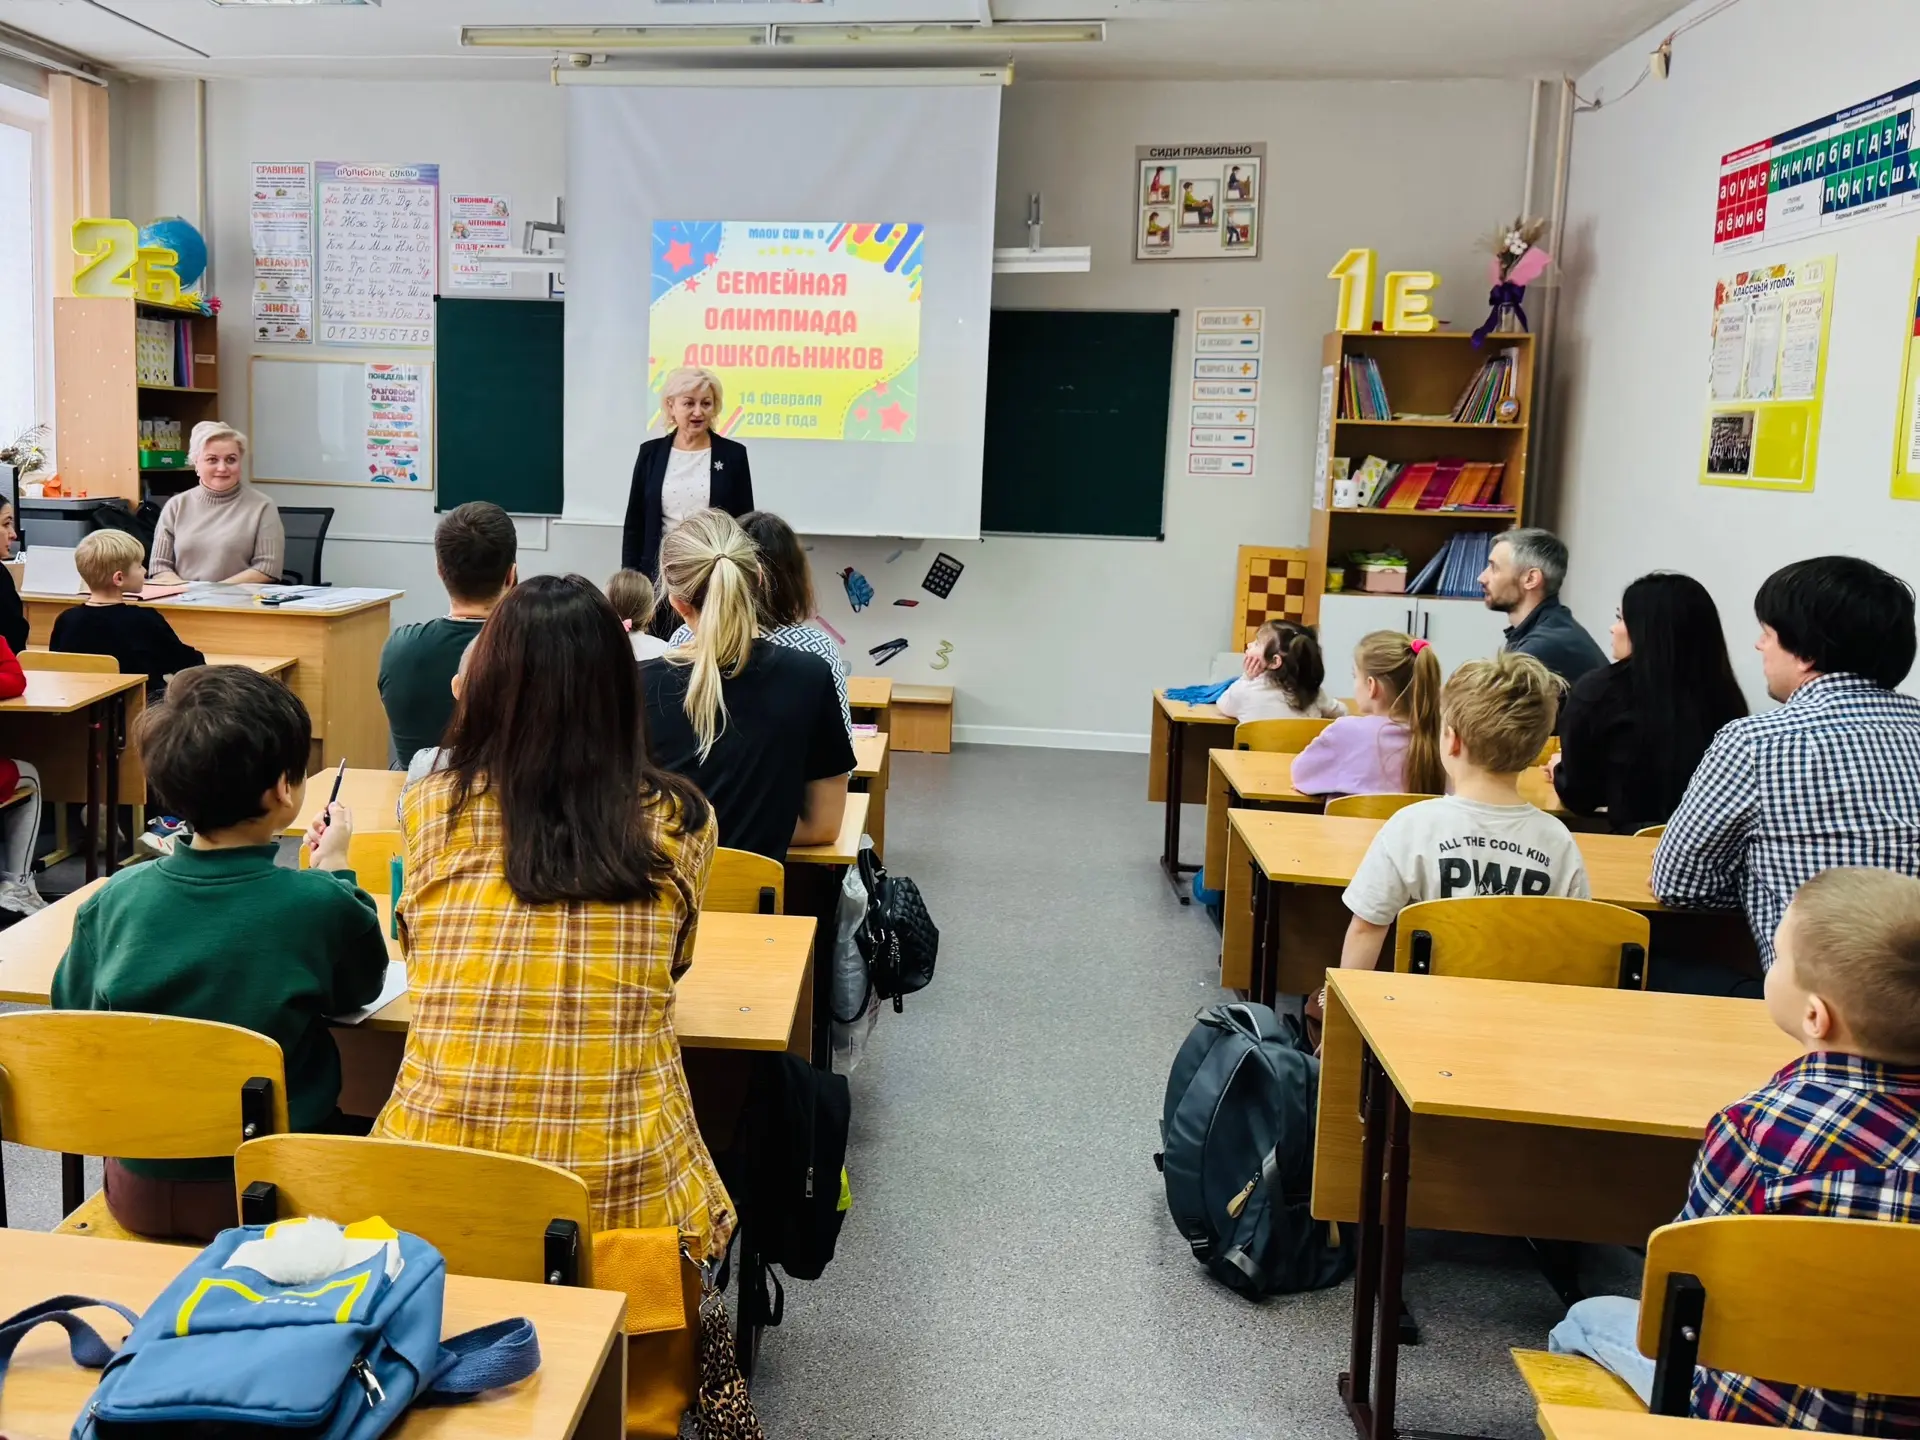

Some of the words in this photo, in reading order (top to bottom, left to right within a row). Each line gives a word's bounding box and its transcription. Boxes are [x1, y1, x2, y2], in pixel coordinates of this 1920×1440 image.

[1149, 147, 1181, 159] СИДИ
[1183, 145, 1252, 157] ПРАВИЛЬНО
[256, 165, 306, 175] СРАВНЕНИЕ
[337, 168, 386, 177] ПРОПИСНЫЕ
[389, 169, 417, 178] БУКВЫ
[715, 267, 849, 297] СЕМЕЙНАЯ
[1733, 279, 1769, 298] КЛАССНЫЙ
[1769, 275, 1796, 291] УГОЛОК
[704, 307, 858, 337] ОЛИМПИАДА
[682, 343, 885, 371] ДОШКОЛЬНИКОВ
[739, 391, 756, 405] 14
[760, 391, 823, 407] февраля
[746, 412, 781, 426] 2026
[785, 414, 818, 428] года
[381, 466, 408, 478] ТРУД
[1438, 837, 1462, 853] ALL
[1463, 836, 1486, 848] THE
[1489, 838, 1524, 855] COOL
[1526, 847, 1552, 868] KIDS
